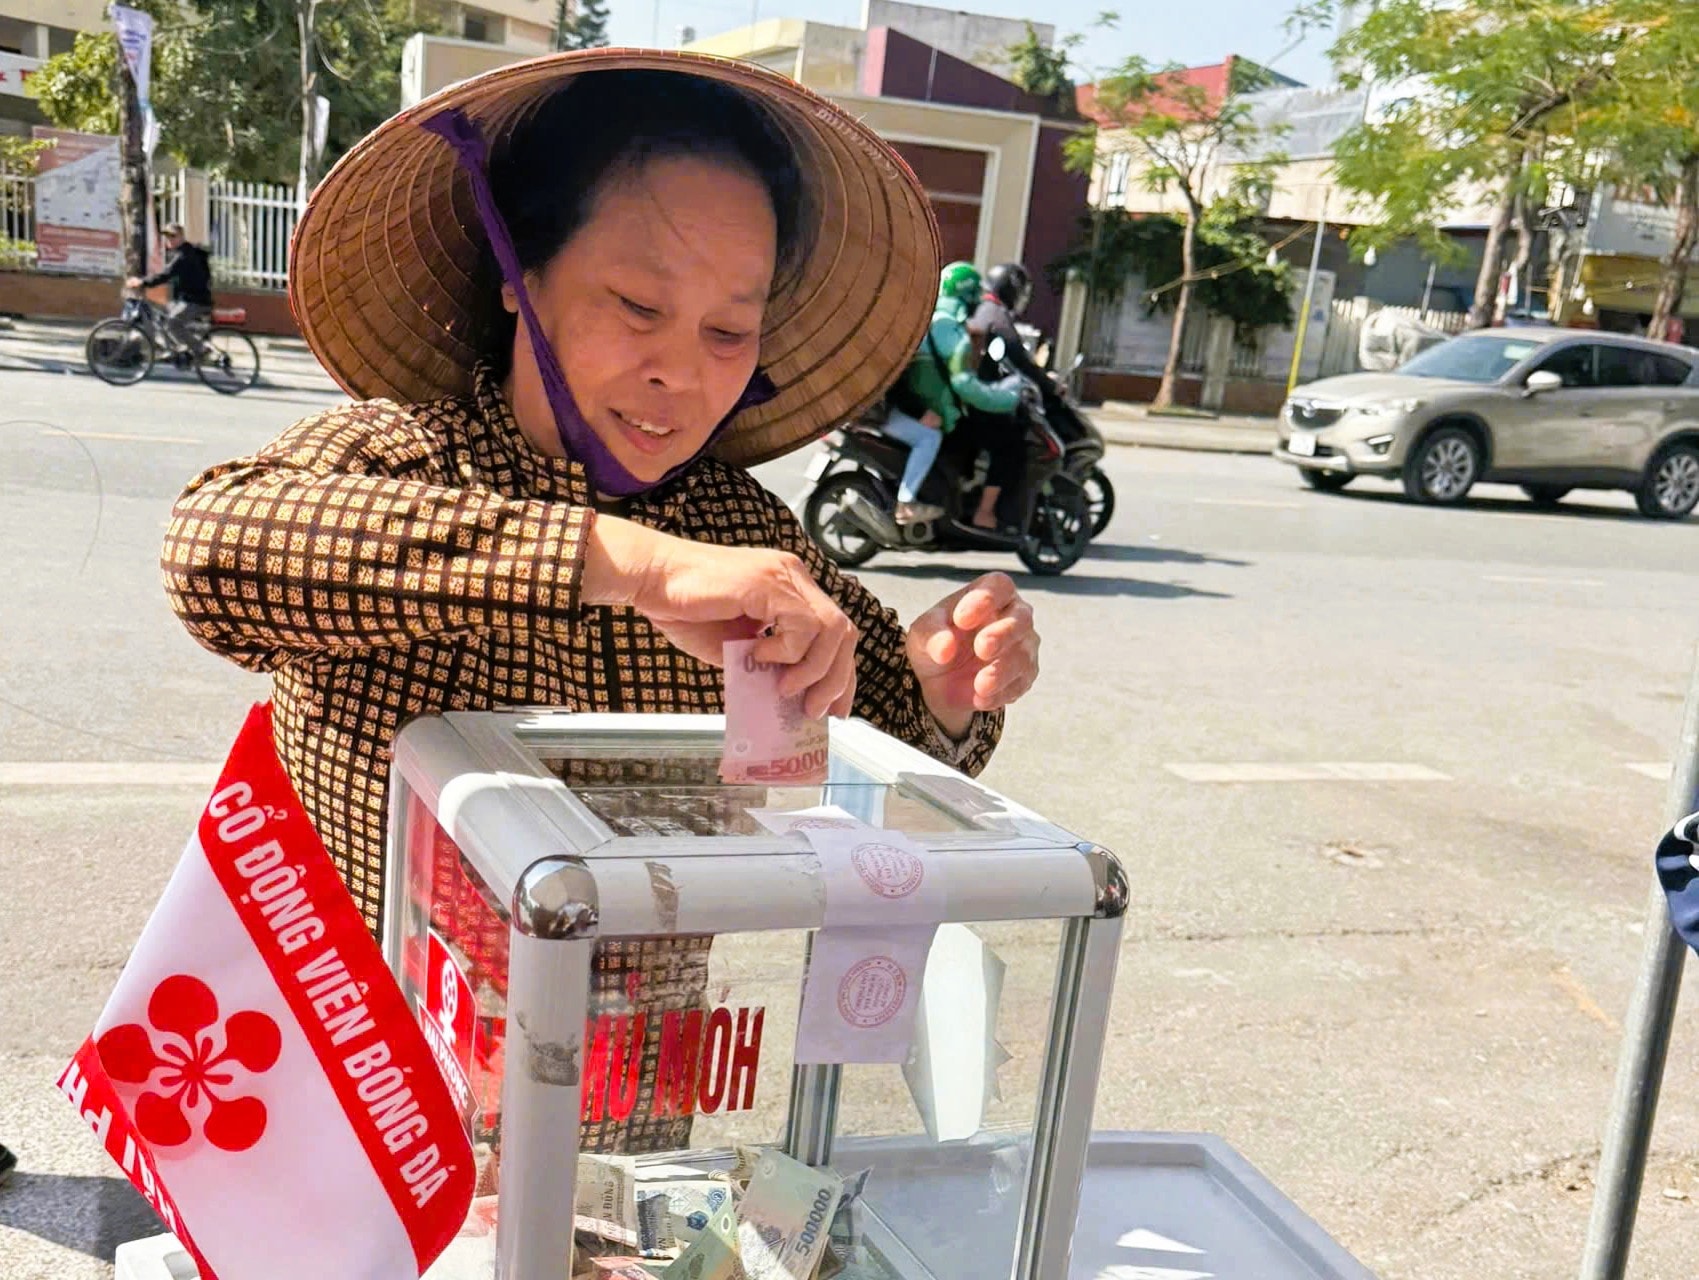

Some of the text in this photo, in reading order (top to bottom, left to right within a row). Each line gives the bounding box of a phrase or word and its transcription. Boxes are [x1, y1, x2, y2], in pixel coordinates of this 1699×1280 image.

[208, 781, 457, 1209] CỔ ĐỘNG VIÊN BÓNG ĐÁ
[795, 1187, 832, 1257] 500000
